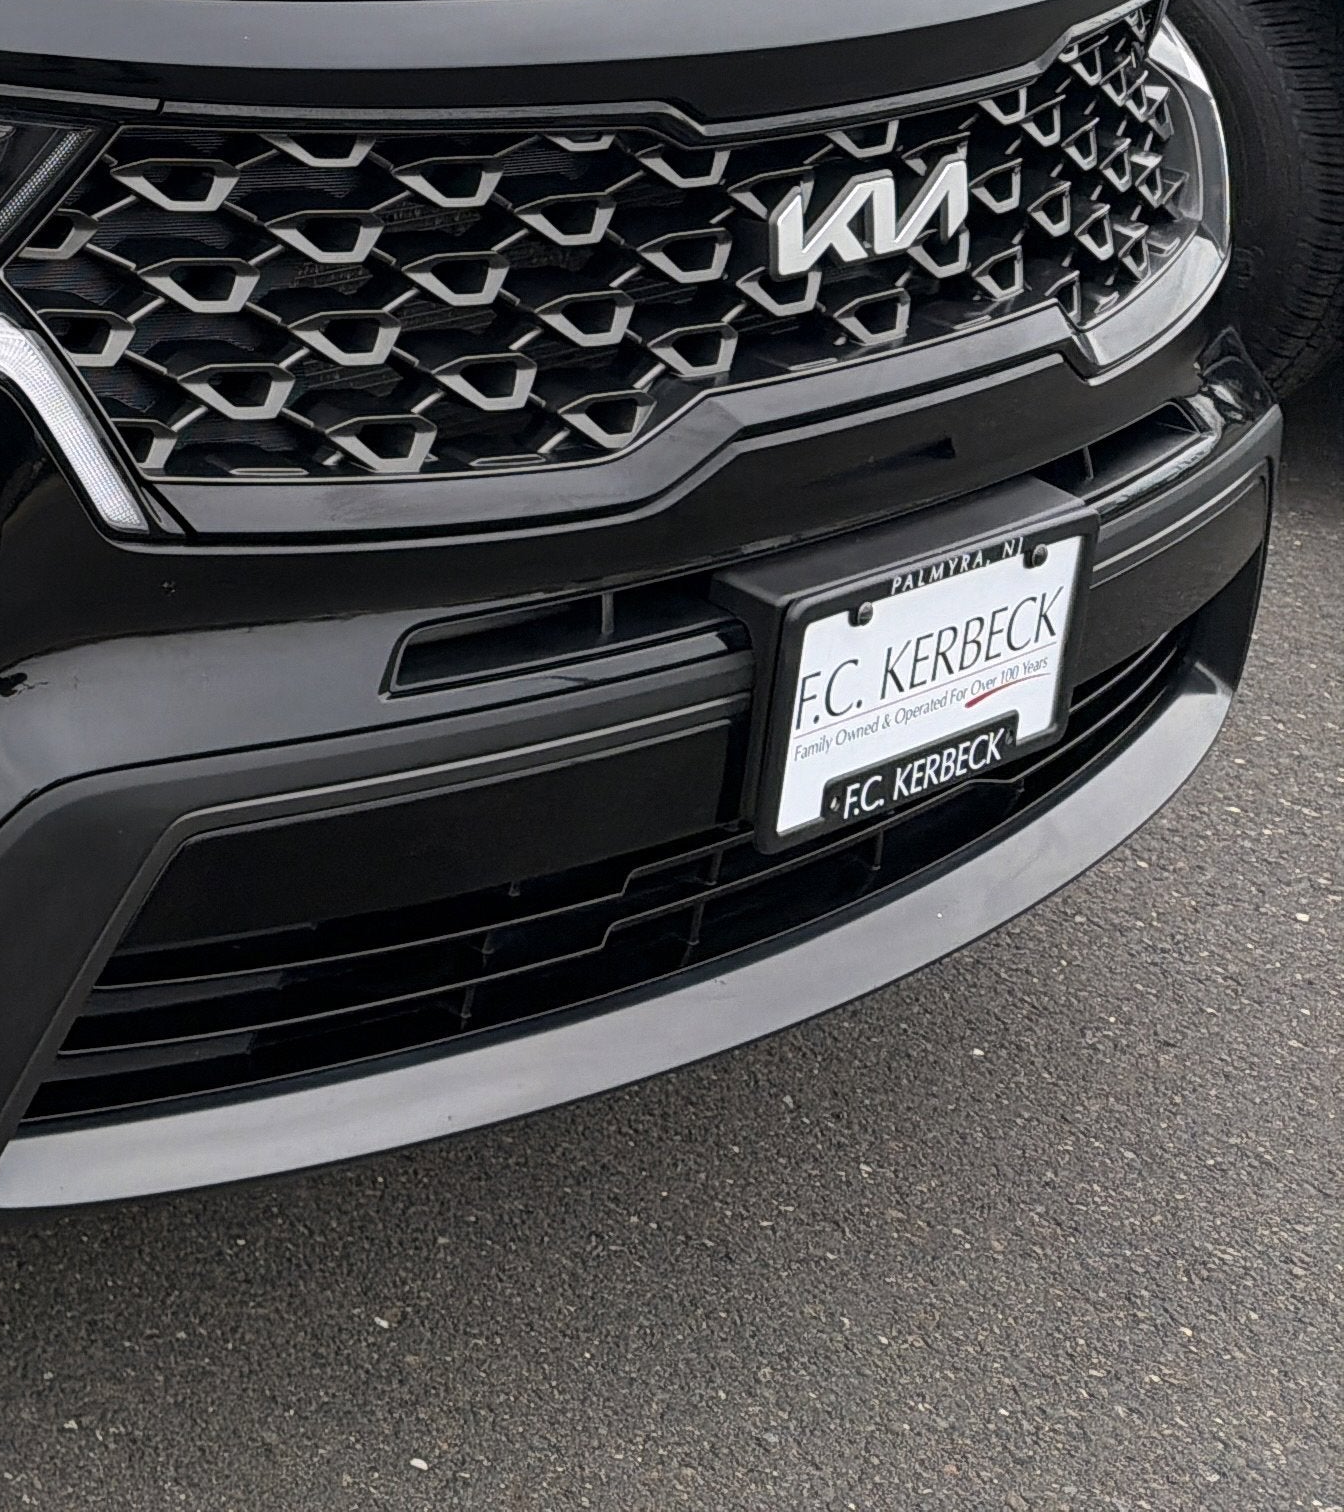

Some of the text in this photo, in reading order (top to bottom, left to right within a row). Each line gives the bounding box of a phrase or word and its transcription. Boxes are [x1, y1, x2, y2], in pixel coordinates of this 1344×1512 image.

[890, 549, 992, 596] PALMYRA,
[795, 585, 1065, 731] F.C. KERBECK
[793, 656, 1050, 762] Family Owned & Operated For Over 100 Years
[843, 727, 1006, 820] F.C. KERBECK
